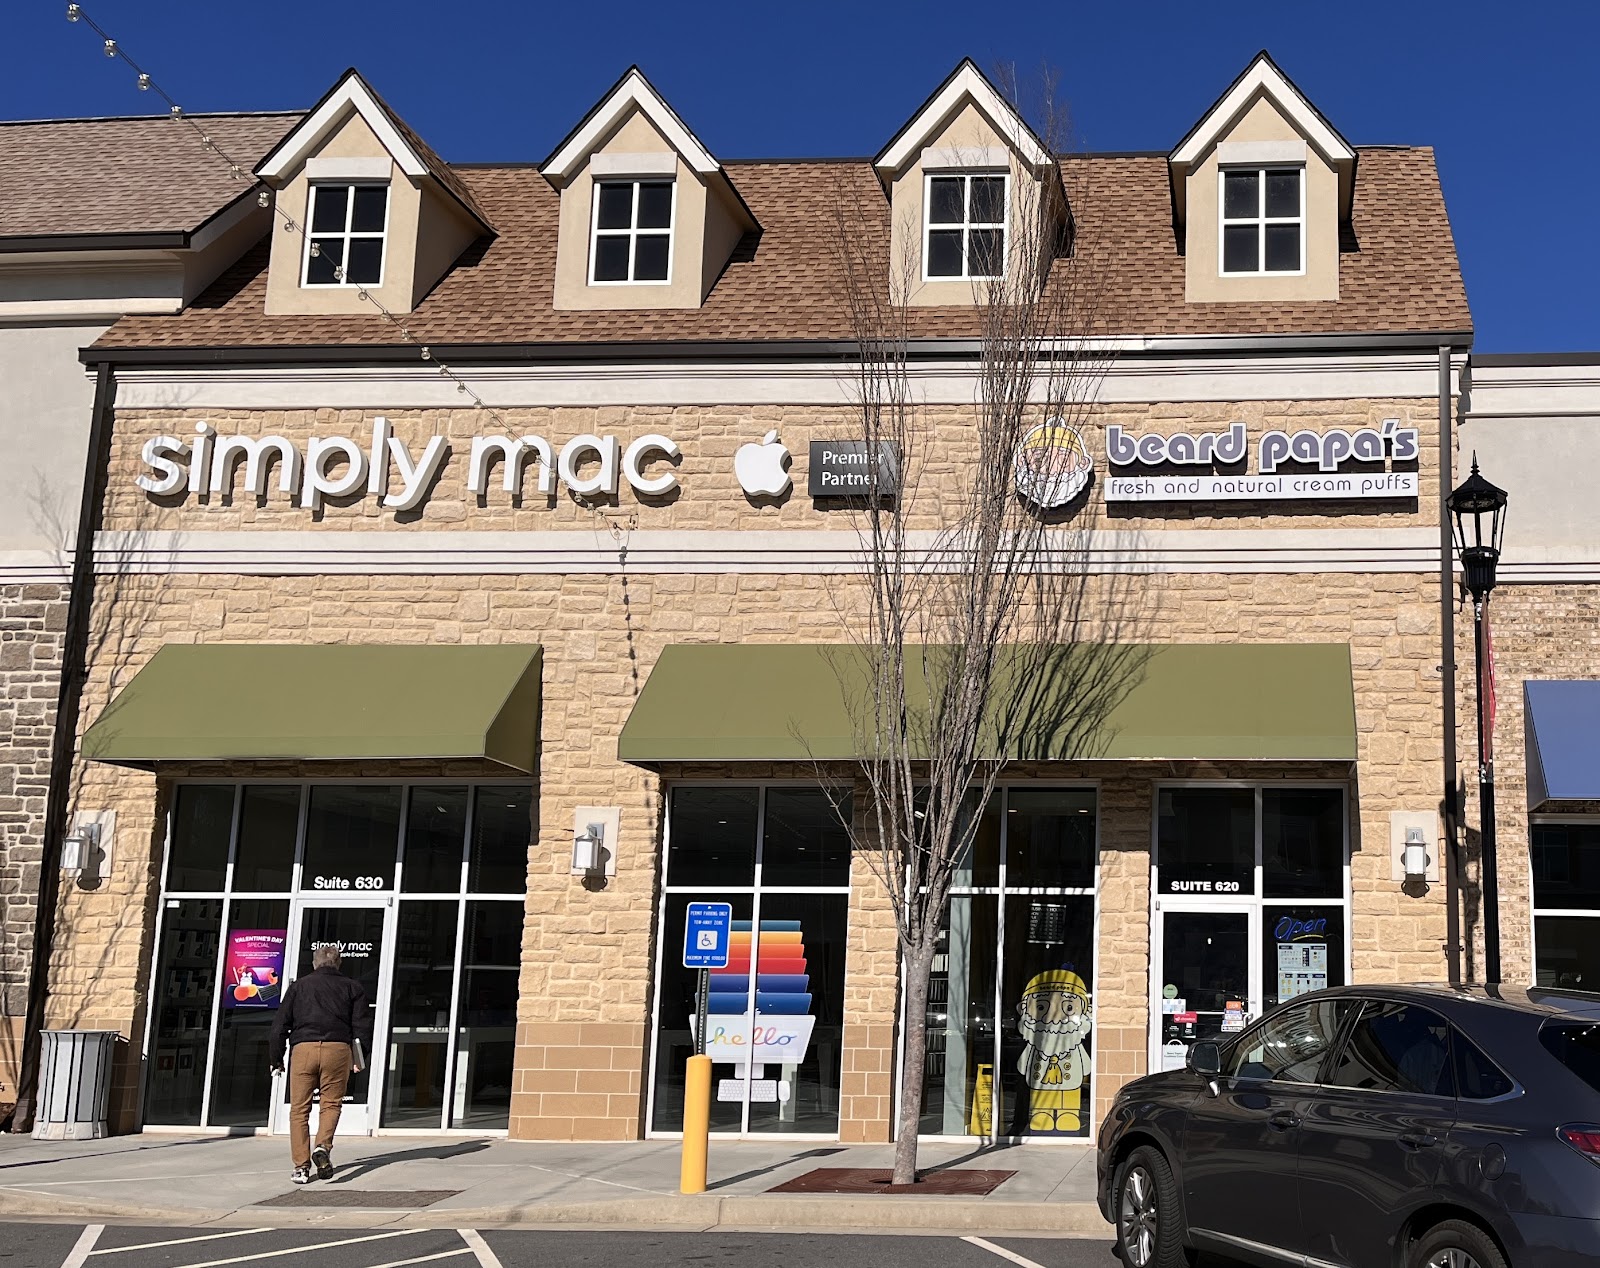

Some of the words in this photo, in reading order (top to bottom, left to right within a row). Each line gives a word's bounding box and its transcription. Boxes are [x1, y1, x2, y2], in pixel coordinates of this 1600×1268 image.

[1106, 422, 1247, 465] beard
[1258, 418, 1419, 473] papa's
[135, 416, 448, 509] simply
[467, 432, 681, 497] mac
[1111, 479, 1155, 495] fresh
[1164, 479, 1200, 494] and
[1212, 477, 1282, 493] natural
[1293, 479, 1351, 492] cream
[1361, 474, 1411, 494] puffs
[313, 875, 350, 889] Suite
[354, 876, 384, 889] 630
[1170, 881, 1212, 891] SUITE
[1215, 881, 1240, 892] 620
[1275, 916, 1327, 940] Open
[235, 935, 271, 943] VALENTINE'S
[271, 936, 283, 944] DAY
[348, 942, 373, 951] mac
[707, 1027, 797, 1045] hello
